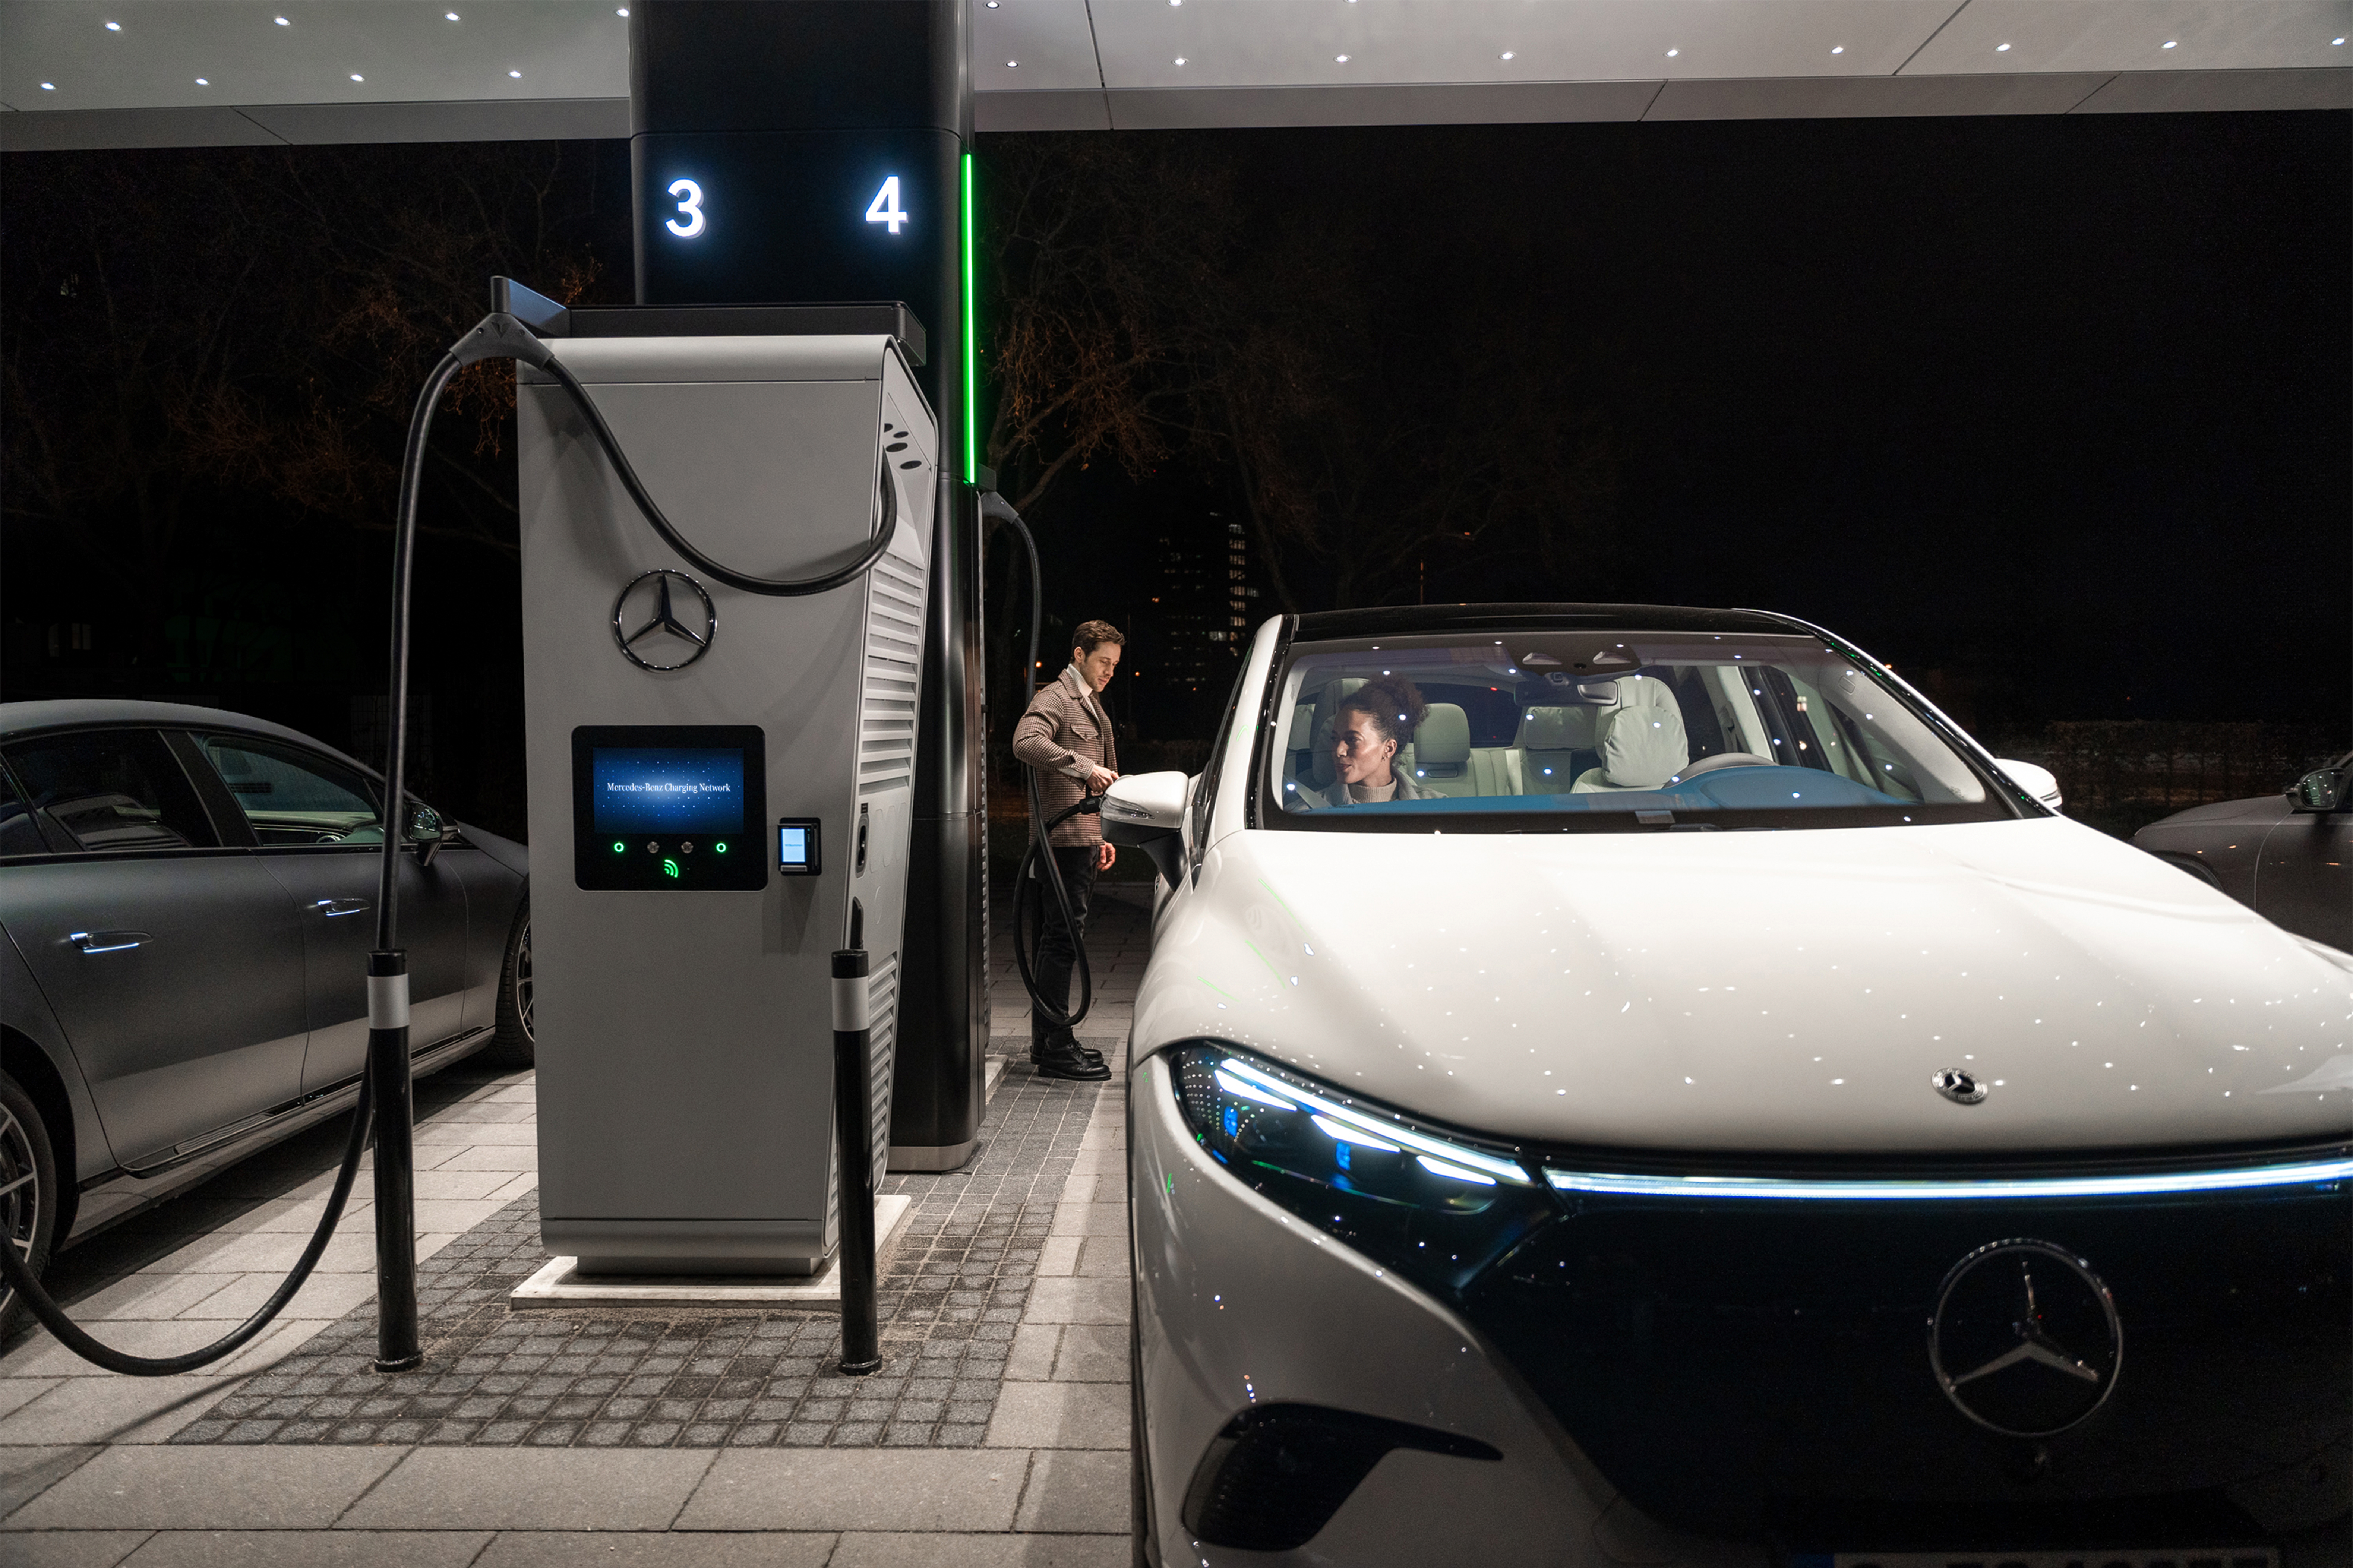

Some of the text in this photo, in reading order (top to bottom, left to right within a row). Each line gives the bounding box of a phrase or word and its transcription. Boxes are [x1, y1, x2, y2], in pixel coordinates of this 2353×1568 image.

[665, 178, 706, 239] 3
[865, 175, 908, 235] 4
[607, 783, 731, 794] Mercedes-Benz Charging Network
